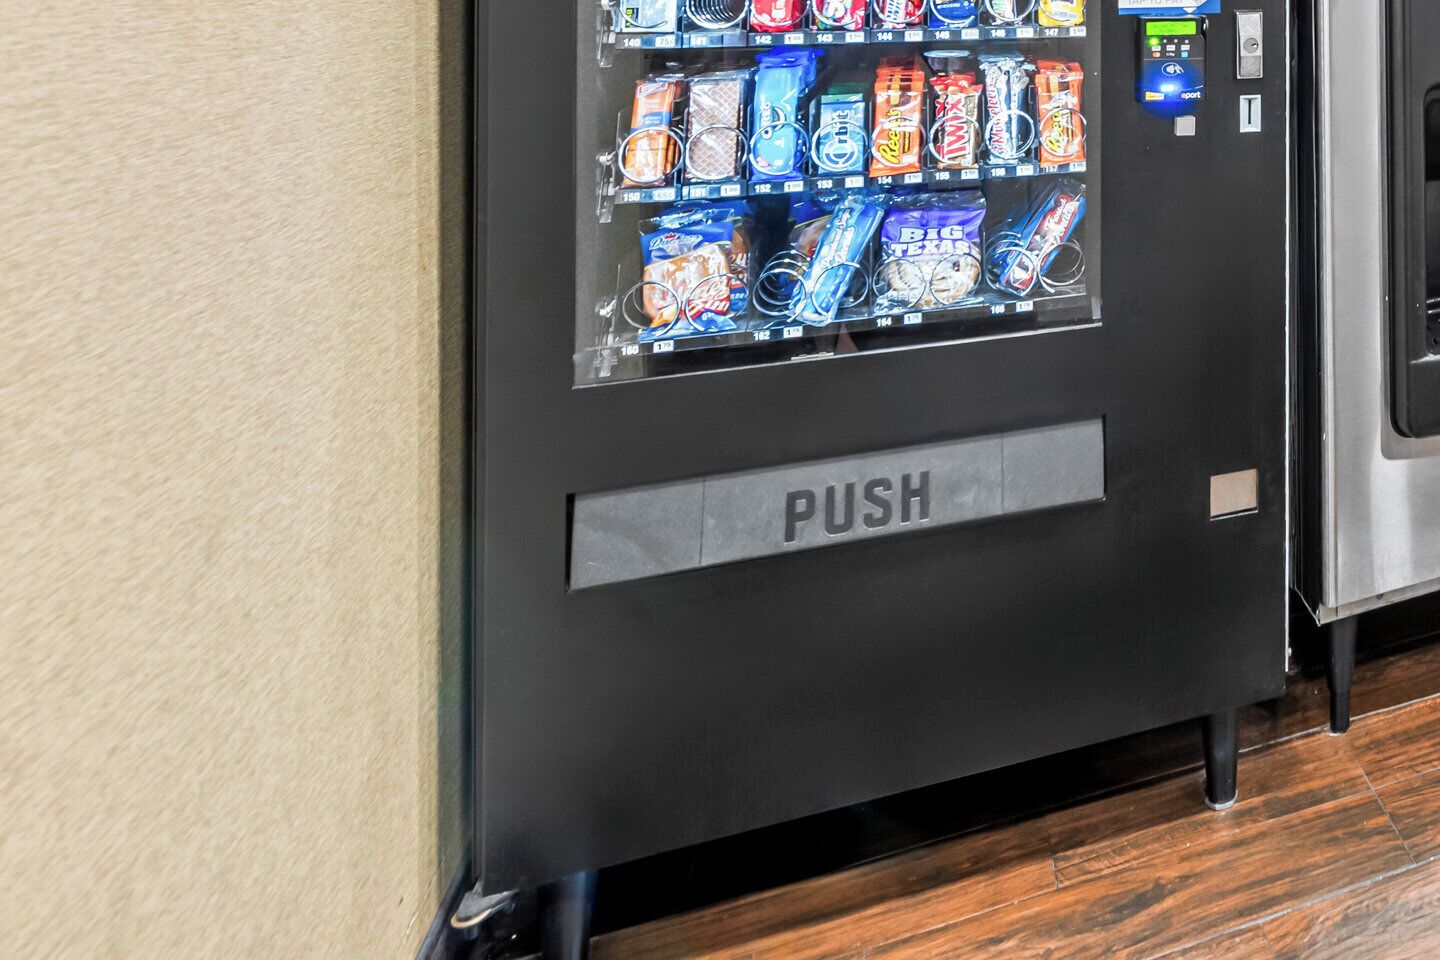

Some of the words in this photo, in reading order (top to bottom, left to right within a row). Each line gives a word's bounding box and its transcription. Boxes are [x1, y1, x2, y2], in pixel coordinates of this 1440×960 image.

[1044, 28, 1059, 36] 147
[755, 35, 772, 44] 142
[1181, 91, 1201, 100] eport
[878, 107, 902, 164] Ree's
[877, 175, 893, 184] 154
[755, 184, 772, 192] 152
[899, 224, 964, 243] BIG
[890, 239, 971, 258] TEXAS
[784, 470, 930, 544] PUSH
